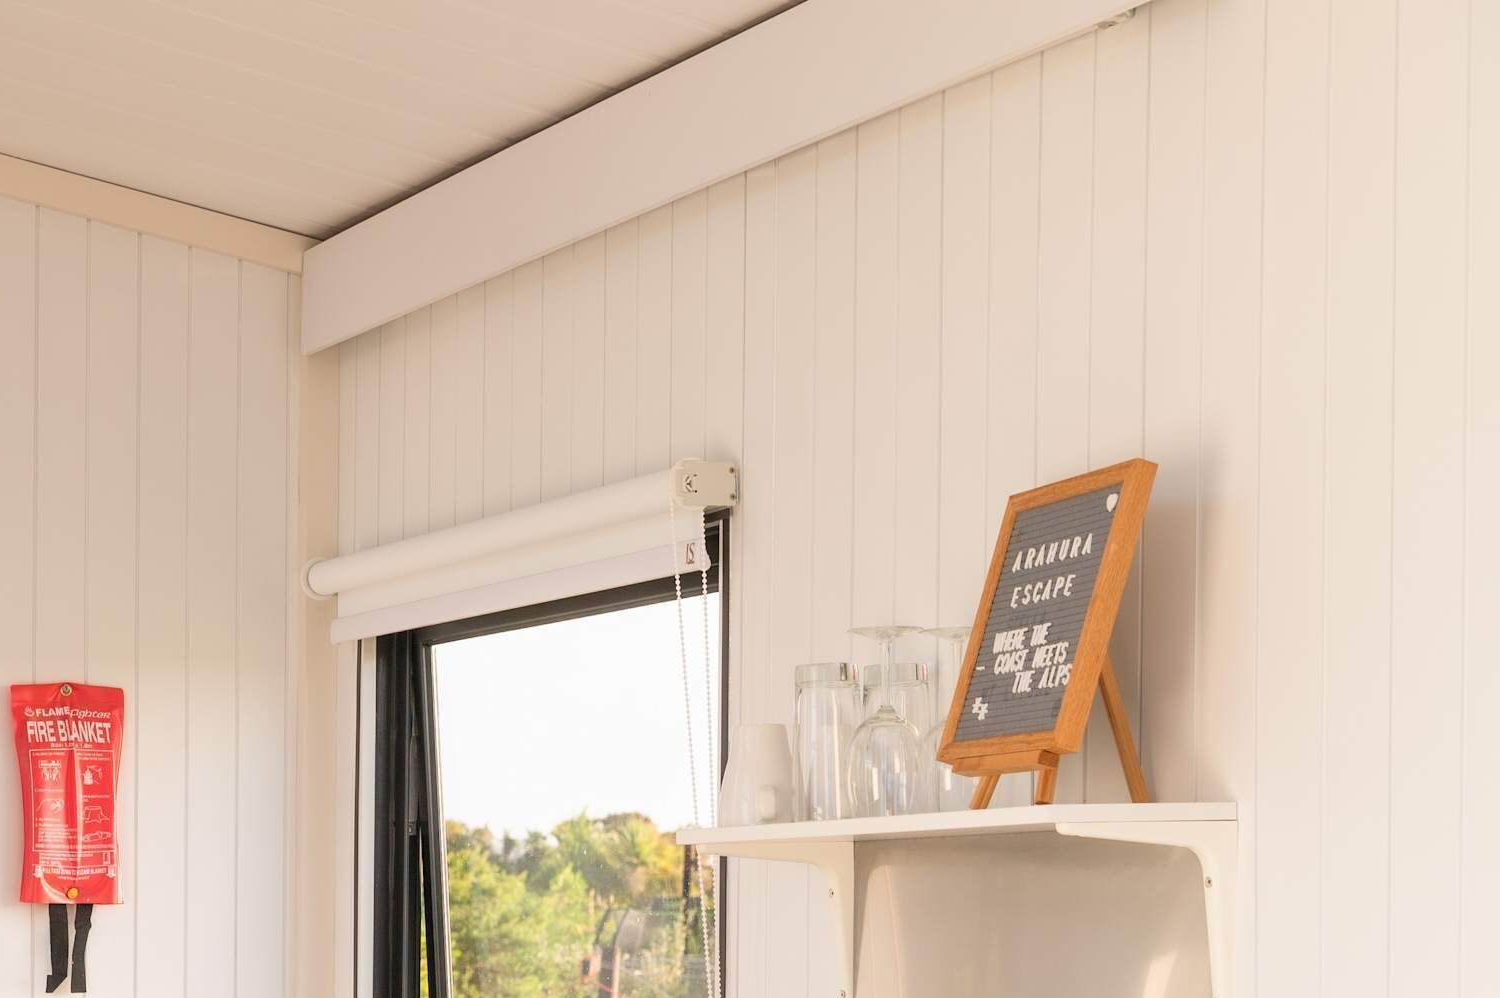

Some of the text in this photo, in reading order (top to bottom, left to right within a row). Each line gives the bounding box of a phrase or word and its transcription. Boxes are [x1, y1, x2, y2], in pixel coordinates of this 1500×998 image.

[1011, 532, 1093, 574] ARAHURA
[1010, 574, 1077, 609] ESCAPE
[993, 622, 1053, 655] WHERE THE
[993, 641, 1070, 675] COAST MEETS
[1012, 663, 1073, 693] THE ALPS
[26, 719, 112, 744] FIRE BLANKET
